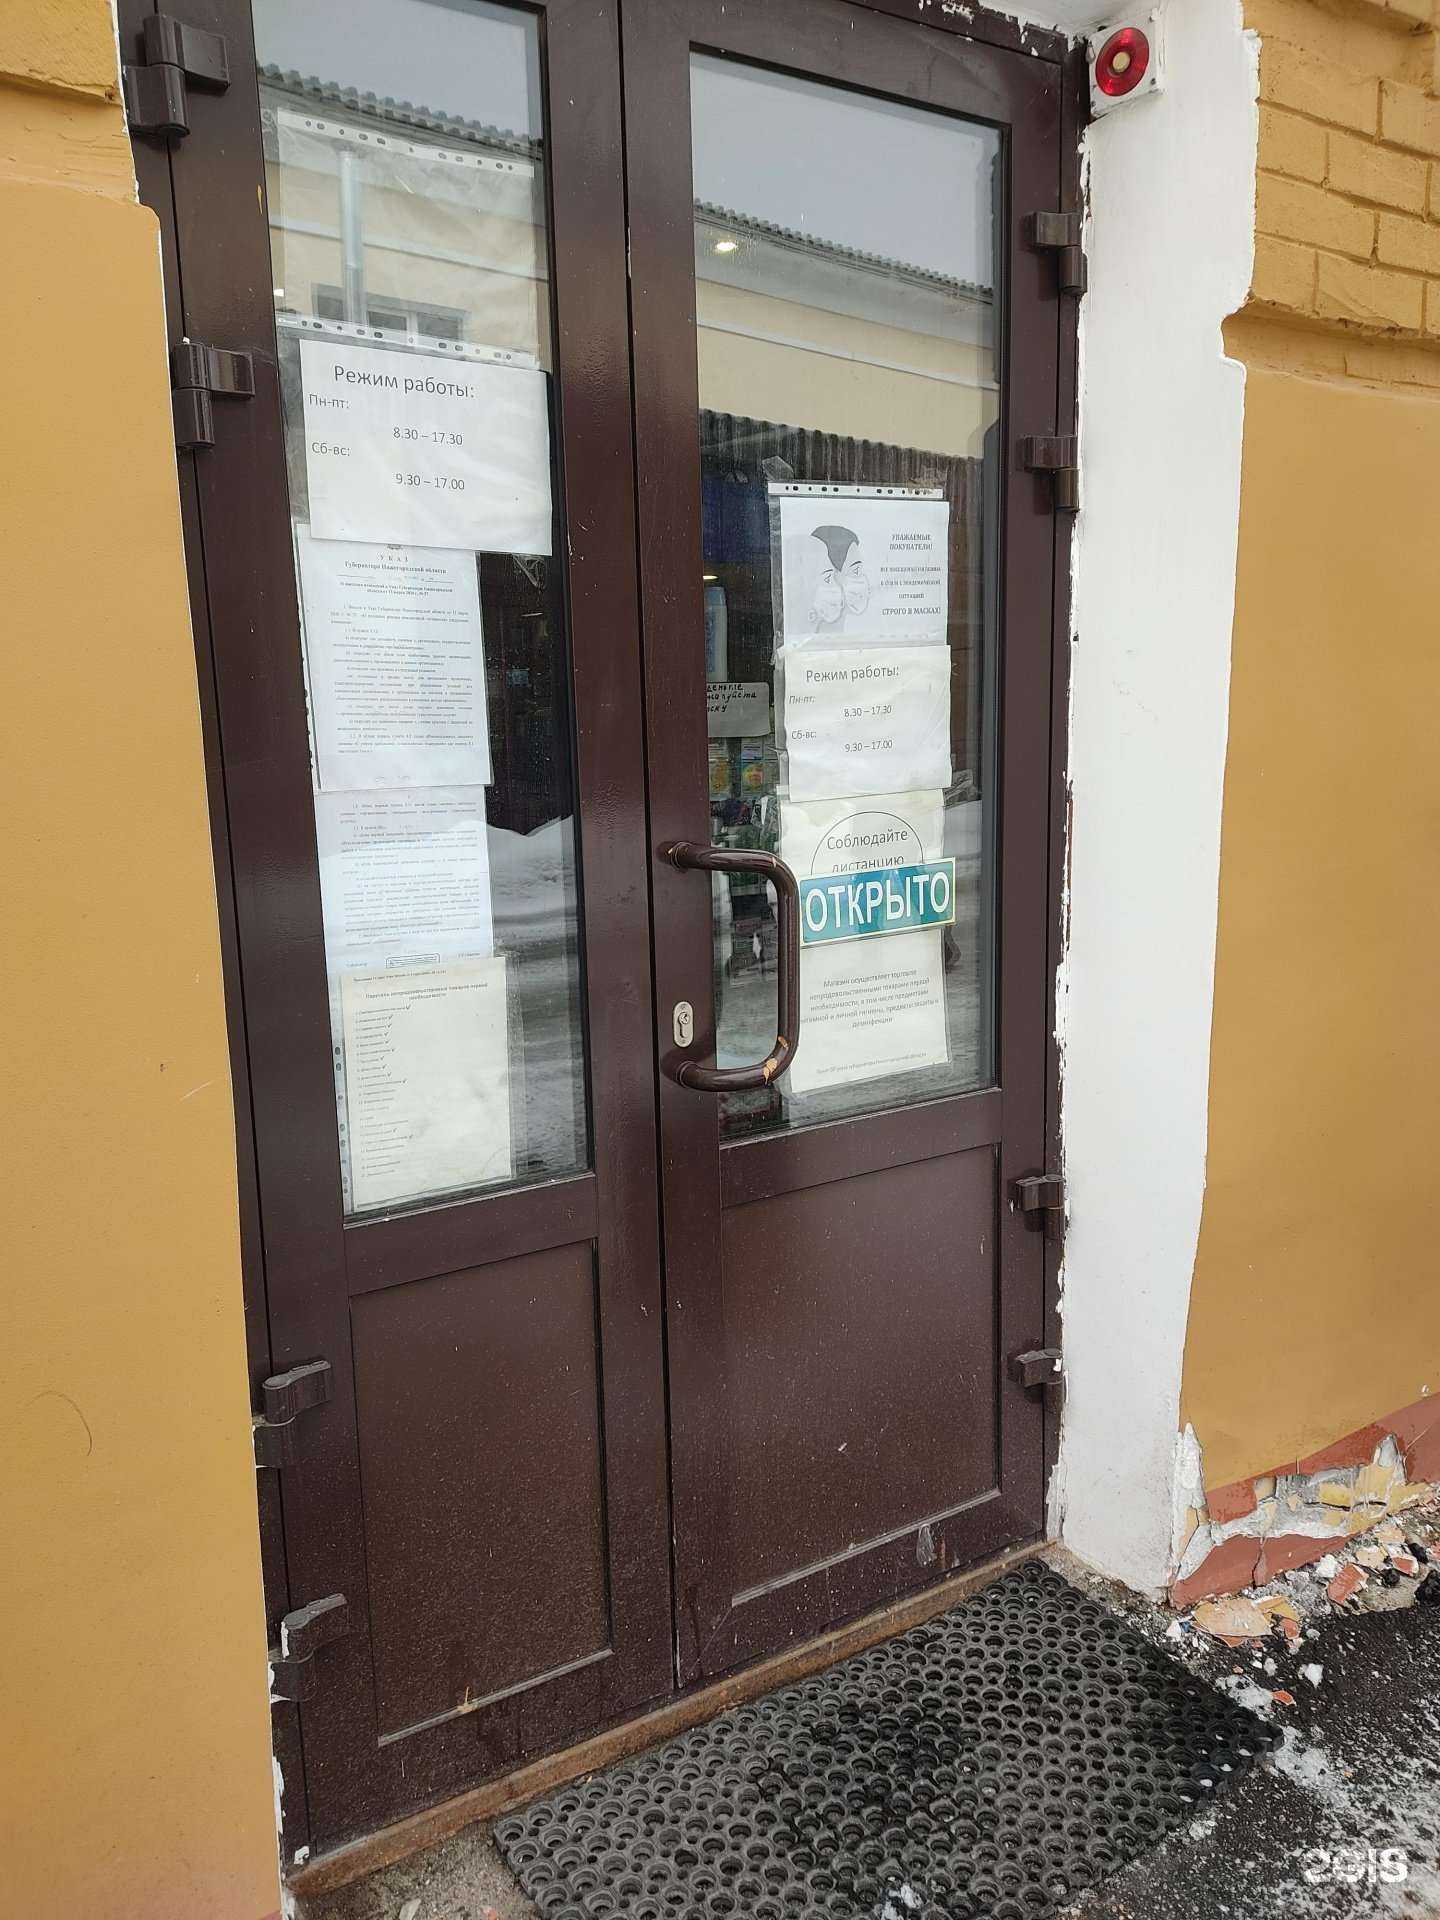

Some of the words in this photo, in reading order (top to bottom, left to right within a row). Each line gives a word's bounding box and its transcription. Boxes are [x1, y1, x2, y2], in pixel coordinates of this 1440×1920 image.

[334, 365, 398, 389] Режим
[404, 376, 475, 398] работы:
[308, 393, 350, 409] Пн-пт:
[393, 426, 418, 440] 8.30
[432, 431, 463, 446] 17.30
[311, 442, 350, 456] Сб-вс:
[395, 473, 420, 486] 9.30
[434, 477, 465, 490] 17.00
[881, 607, 907, 615] СТРОГО
[913, 606, 941, 615] МАСКАХ!
[806, 669, 848, 683] Режим
[851, 665, 899, 682] работы:
[788, 695, 815, 705] Пн-пт:
[843, 707, 862, 717] 8.30
[871, 704, 892, 715] 17.30
[791, 730, 817, 740] Сб-вс:
[844, 742, 863, 752] 9.30
[871, 739, 893, 750] 17.00
[827, 828, 908, 850] Соблюдайте
[805, 871, 950, 932] ОТКРЫТО
[823, 979, 849, 988] Магазин
